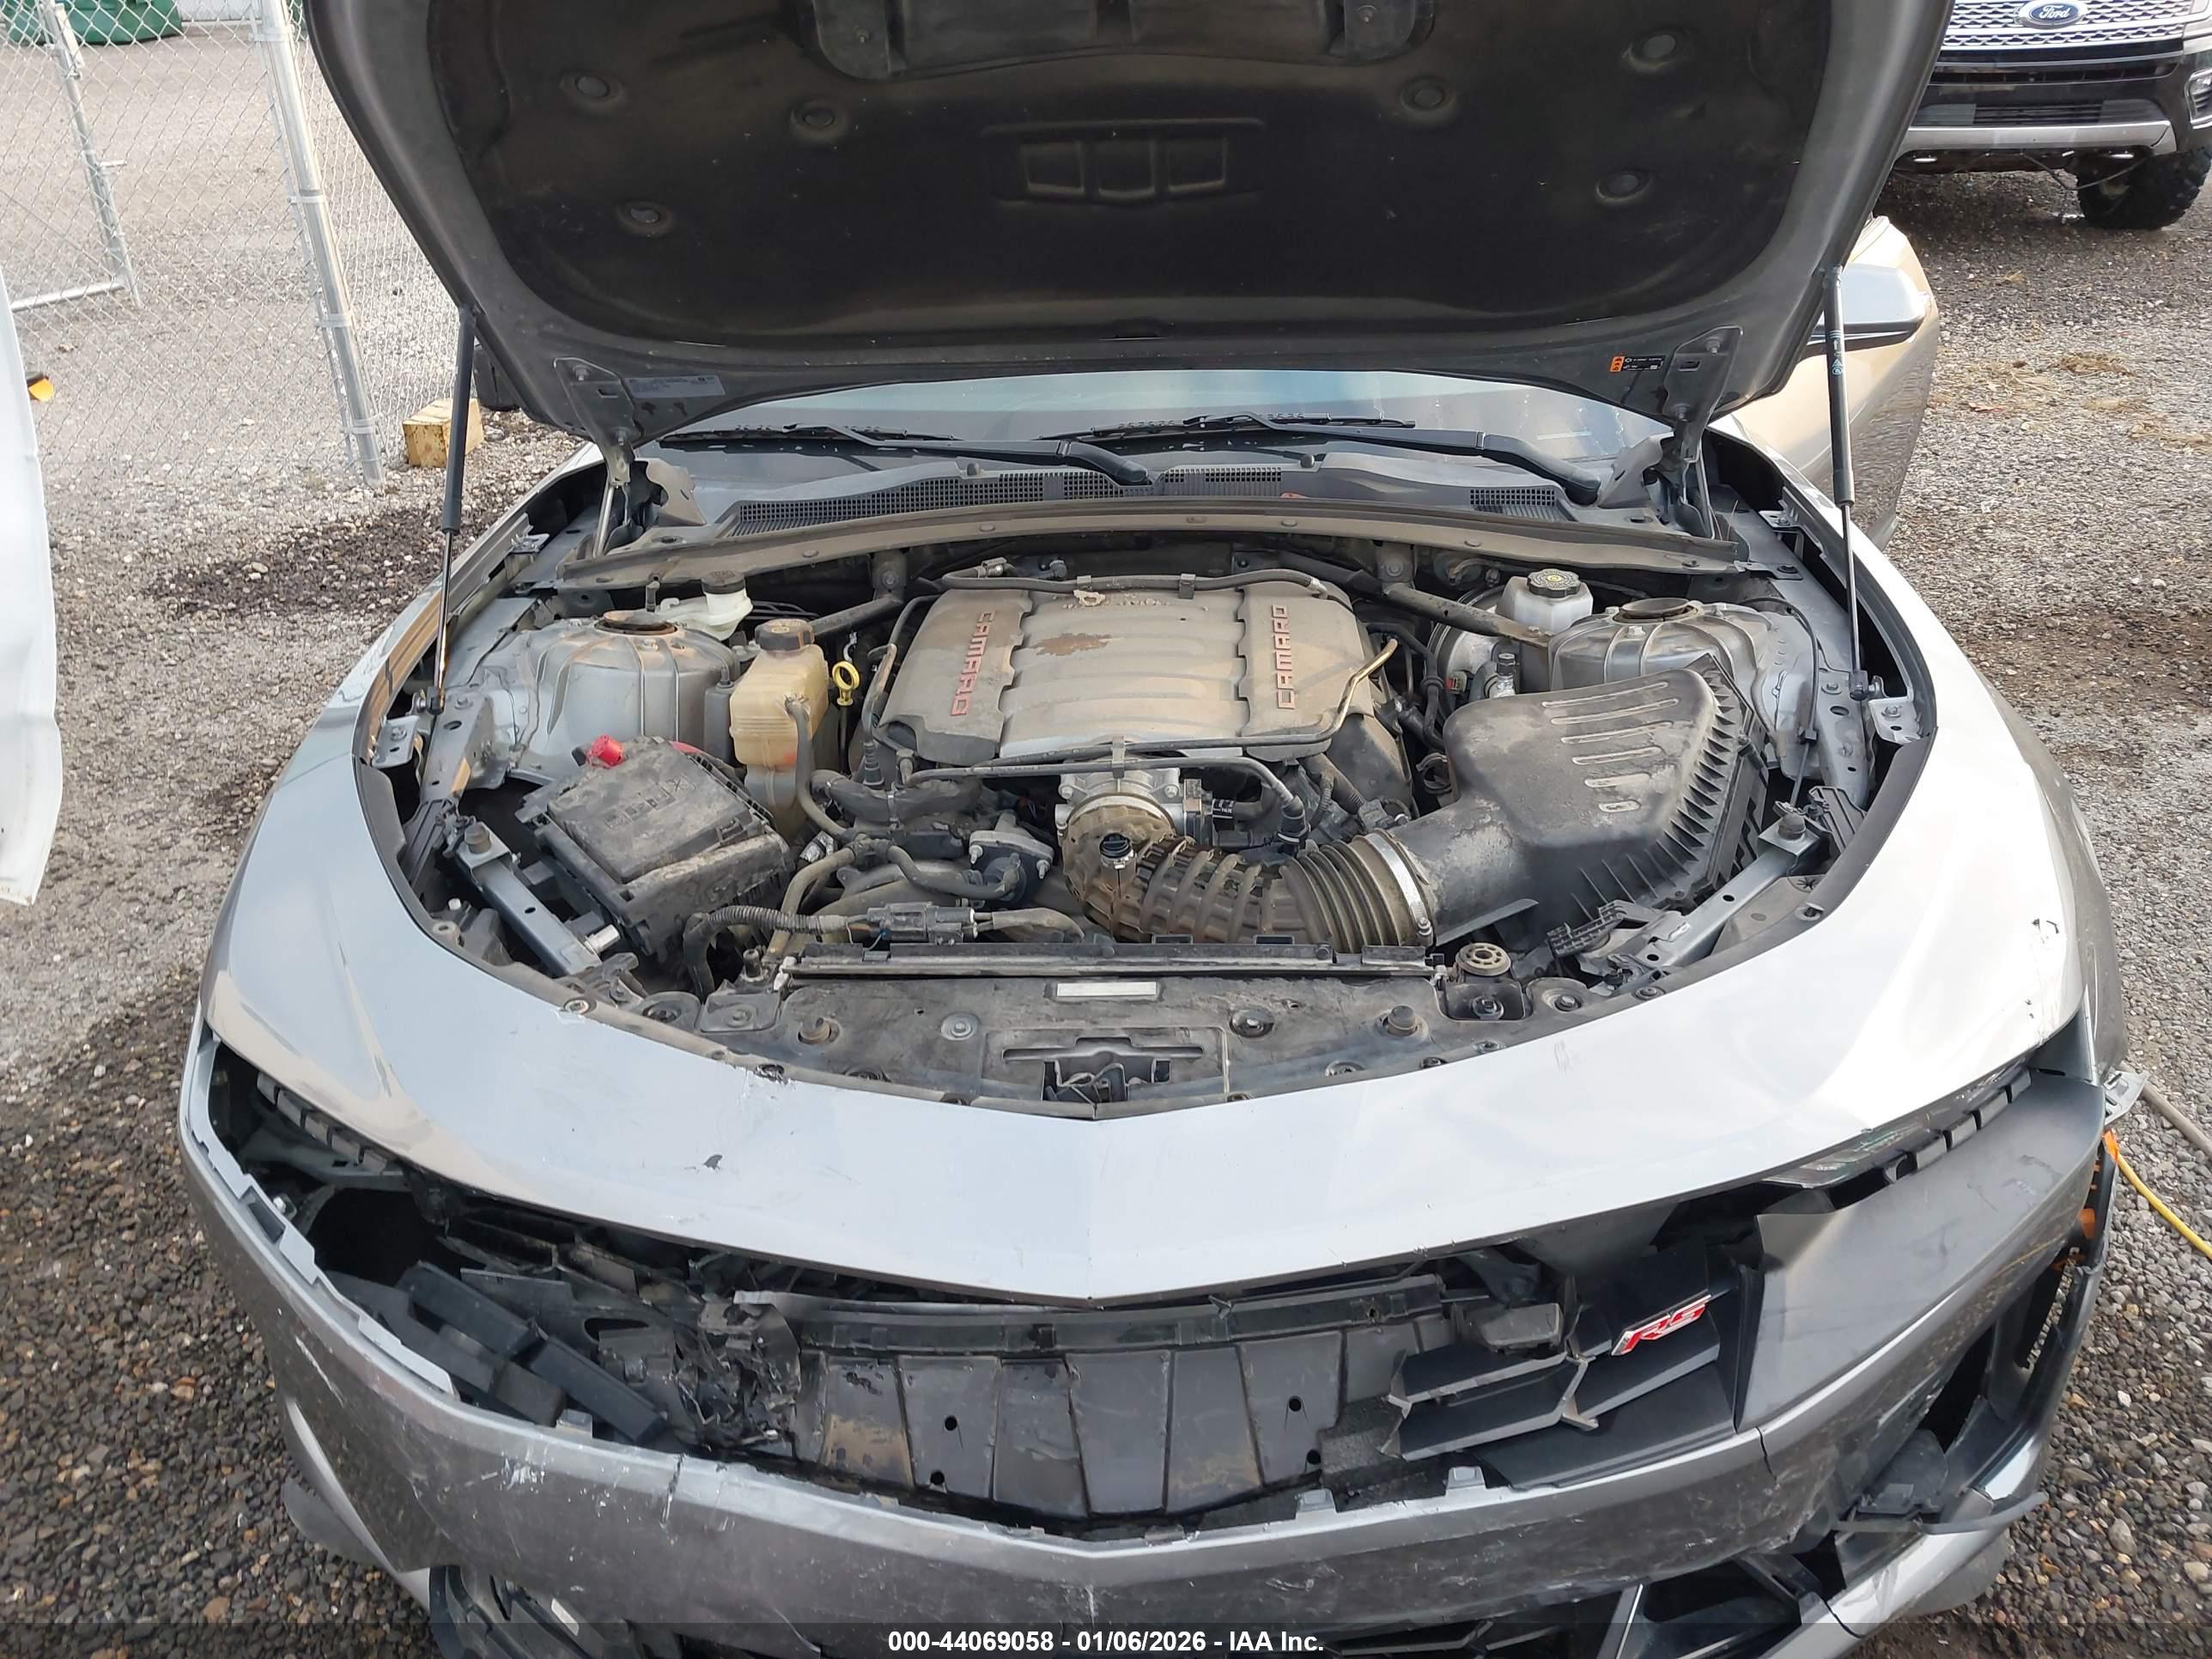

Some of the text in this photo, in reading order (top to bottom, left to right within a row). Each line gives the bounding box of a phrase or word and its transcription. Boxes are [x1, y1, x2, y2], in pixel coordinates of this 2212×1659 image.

[2039, 4, 2070, 19] Ford
[951, 611, 996, 716] CAMARO
[1272, 604, 1296, 709] CAMARO
[1611, 1293, 1711, 1356] RS
